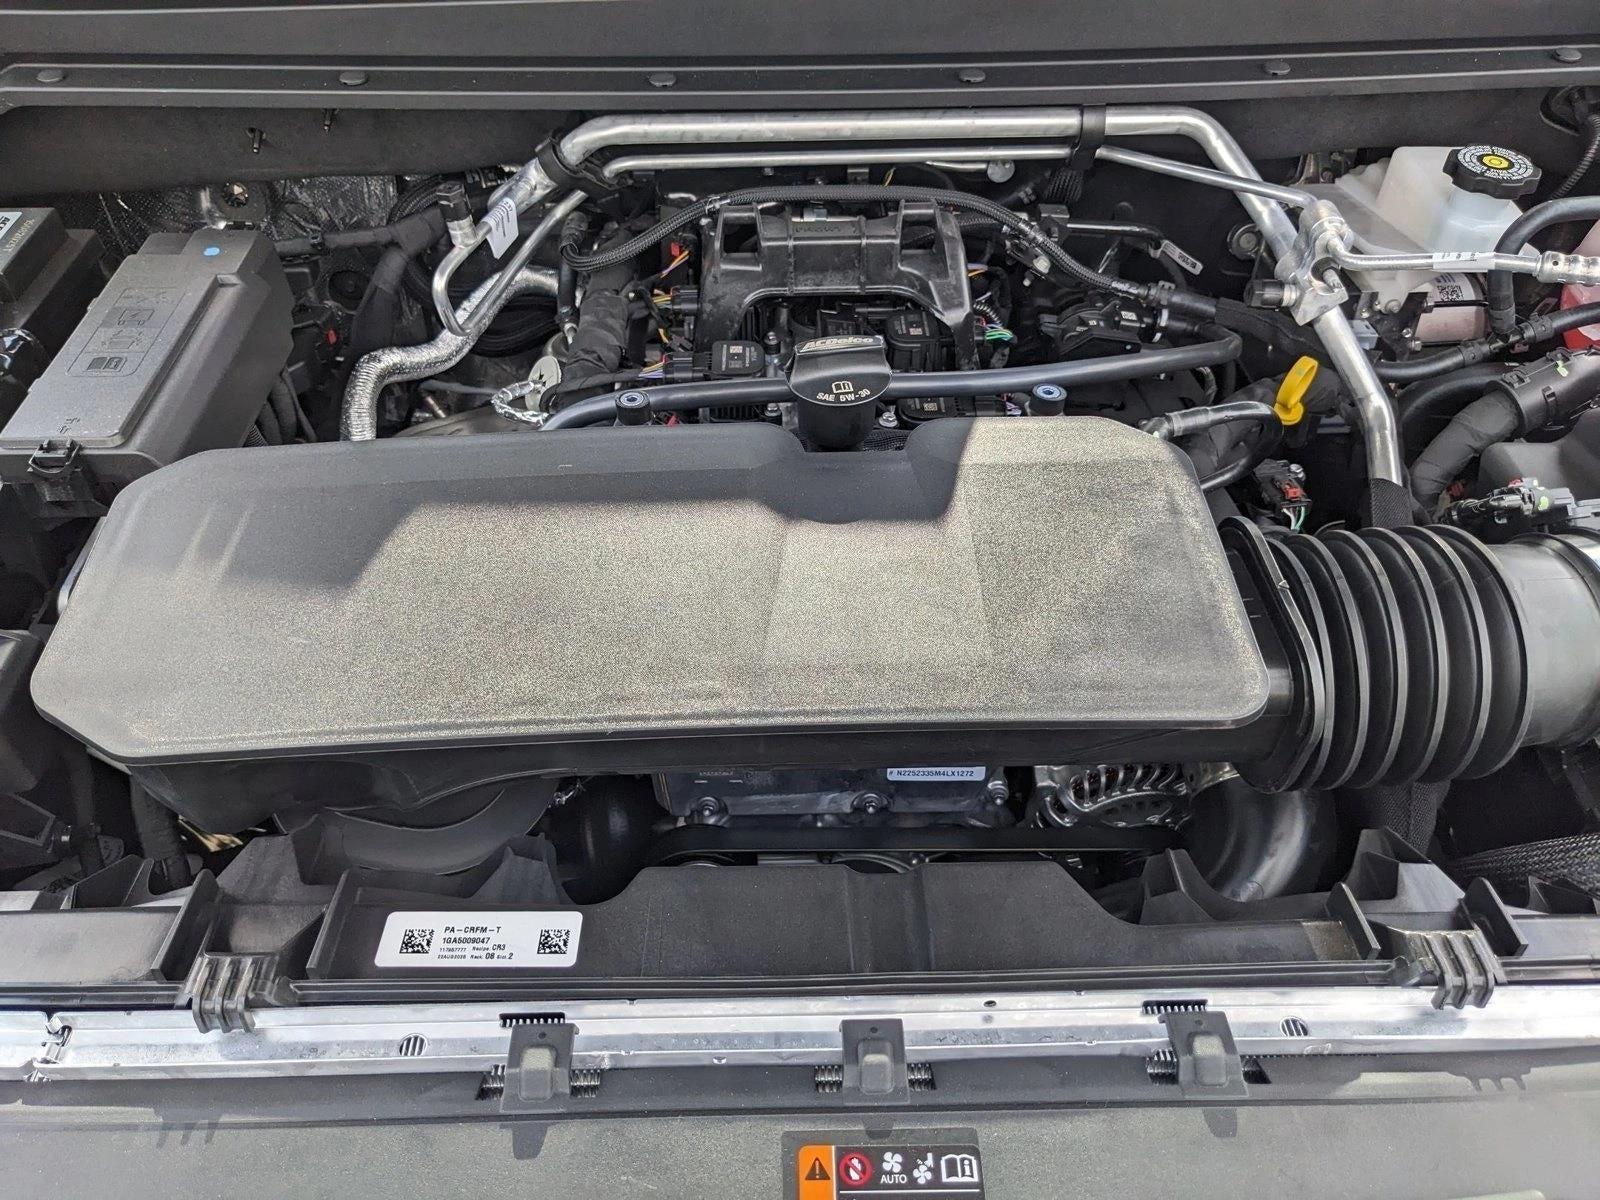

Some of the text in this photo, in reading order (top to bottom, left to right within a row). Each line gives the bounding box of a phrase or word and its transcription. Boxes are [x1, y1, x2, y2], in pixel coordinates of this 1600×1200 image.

[801, 337, 874, 352] ACDelco
[816, 388, 871, 402] SAE 5W-30
[485, 952, 495, 960] 08
[508, 952, 513, 960] 2
[880, 1174, 907, 1184] AUTO
